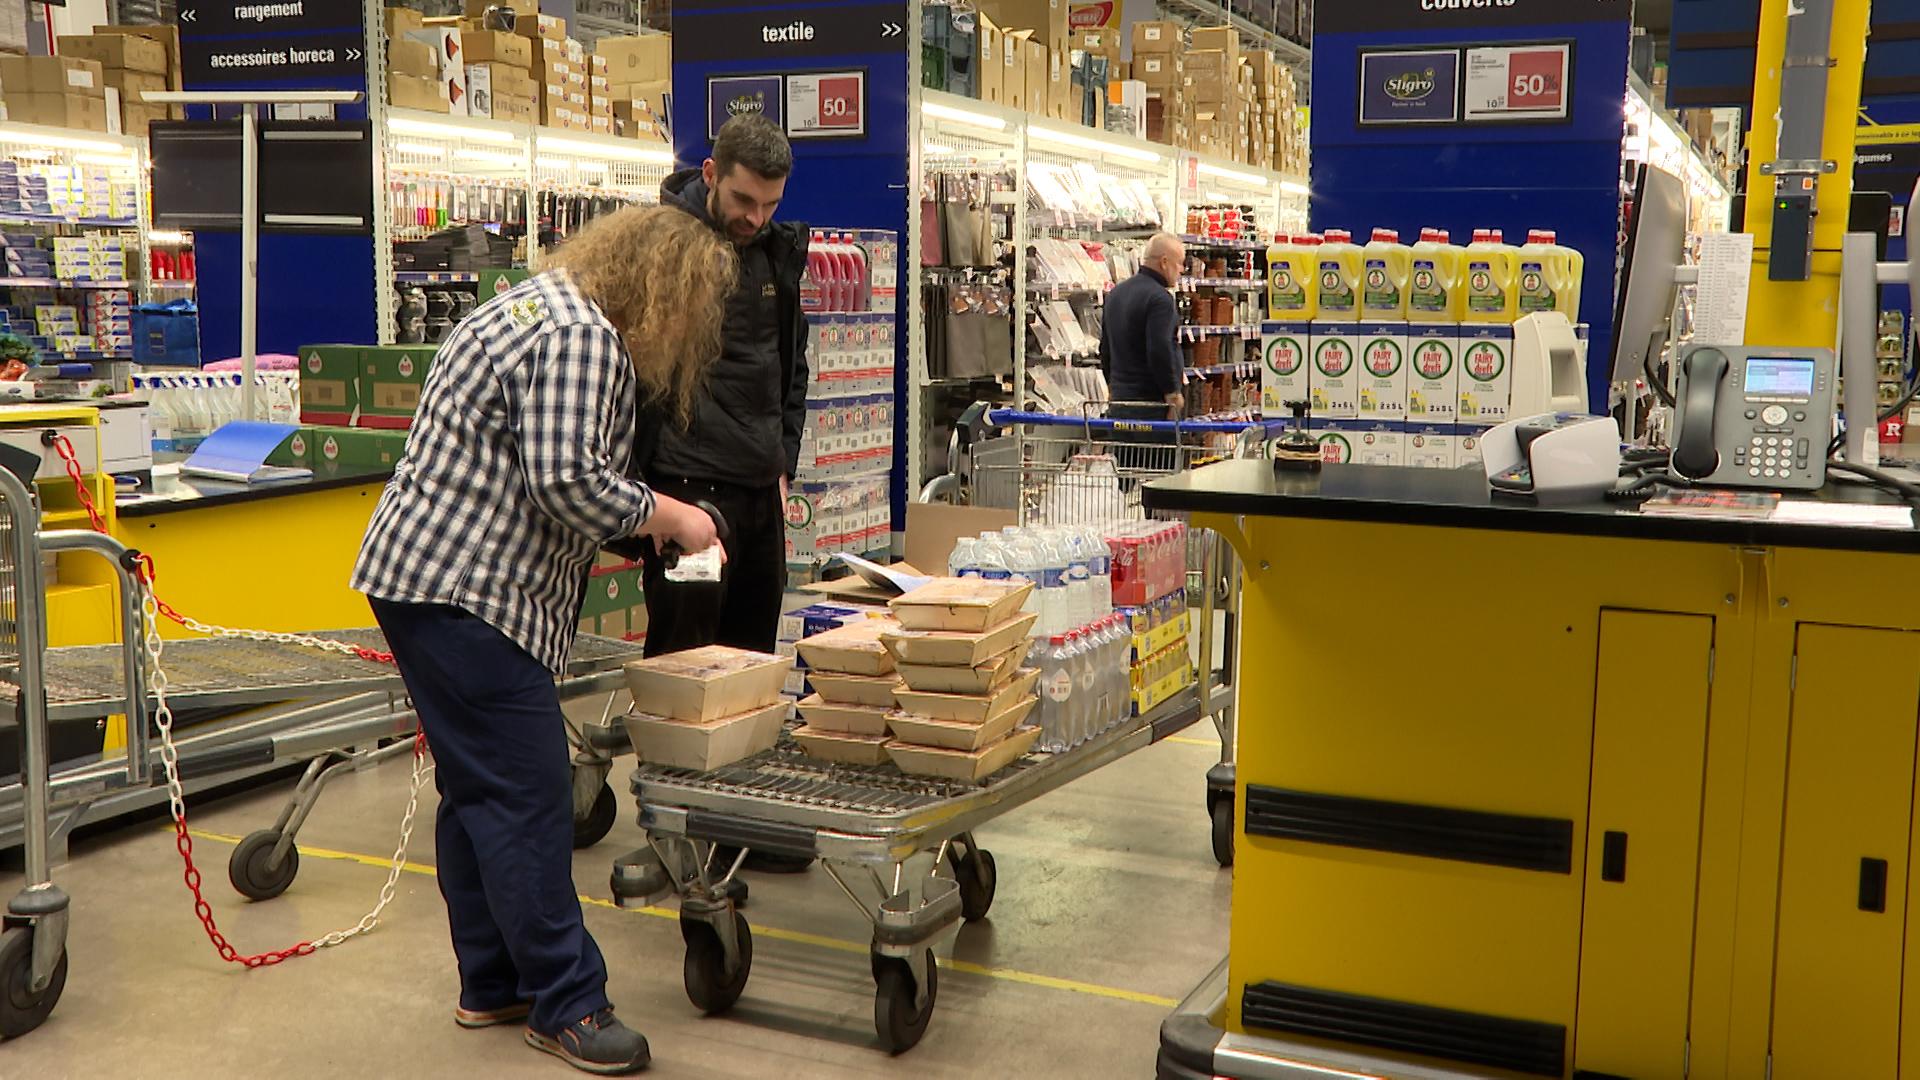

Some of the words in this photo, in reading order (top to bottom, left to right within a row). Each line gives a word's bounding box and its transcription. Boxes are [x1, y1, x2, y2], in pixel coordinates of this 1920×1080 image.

[234, 1, 303, 22] rangement
[762, 21, 815, 43] textile
[211, 51, 288, 68] accessoires
[290, 47, 335, 64] horeca
[1387, 78, 1432, 93] Sligro
